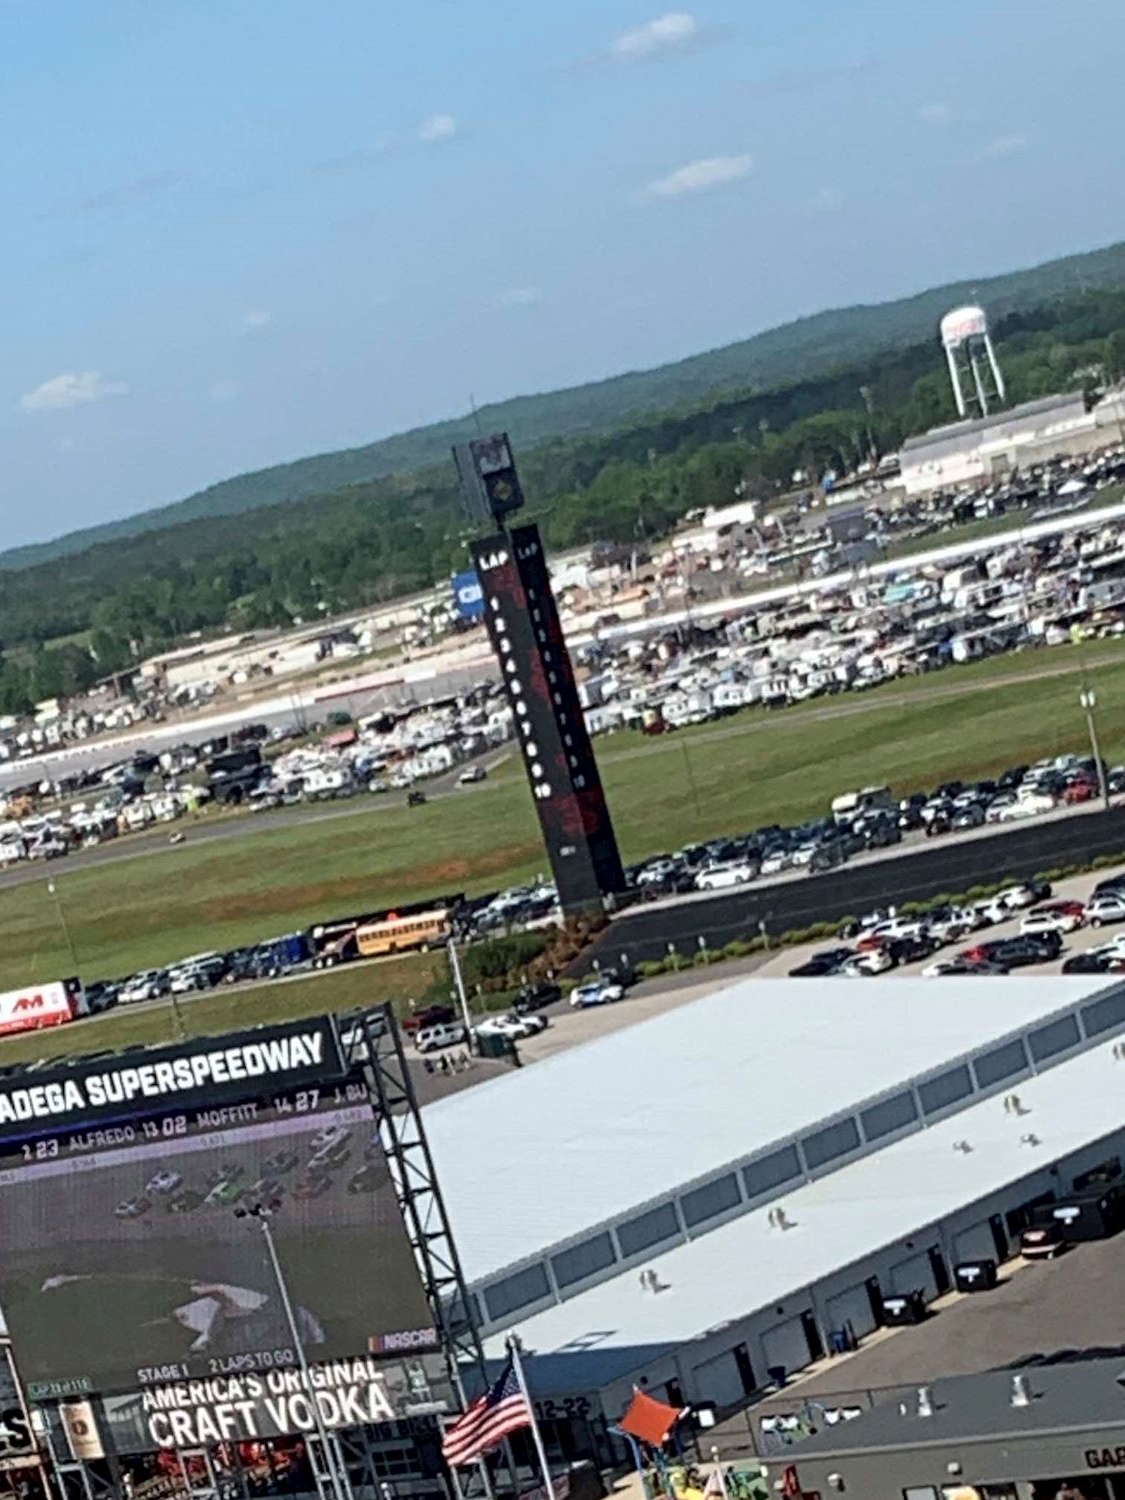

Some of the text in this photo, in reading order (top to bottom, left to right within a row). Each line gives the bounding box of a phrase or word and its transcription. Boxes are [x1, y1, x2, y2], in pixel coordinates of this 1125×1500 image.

[479, 550, 508, 571] LAP
[535, 782, 551, 798] 10
[84, 1031, 325, 1106] SUPERSPEEDWAY
[35, 1138, 59, 1160] 23
[69, 1126, 136, 1152] ALFREDO
[162, 1115, 187, 1136] 02
[196, 1103, 258, 1129] MOFFITT
[296, 1089, 321, 1111] 27
[384, 1329, 436, 1349] NASCAR
[209, 1349, 294, 1373] 2 LAPS TO GO
[137, 1364, 179, 1383] STAGE
[142, 1356, 384, 1411] AMERICA'S ORIGINAL
[148, 1383, 395, 1447] CRAFT VODKA
